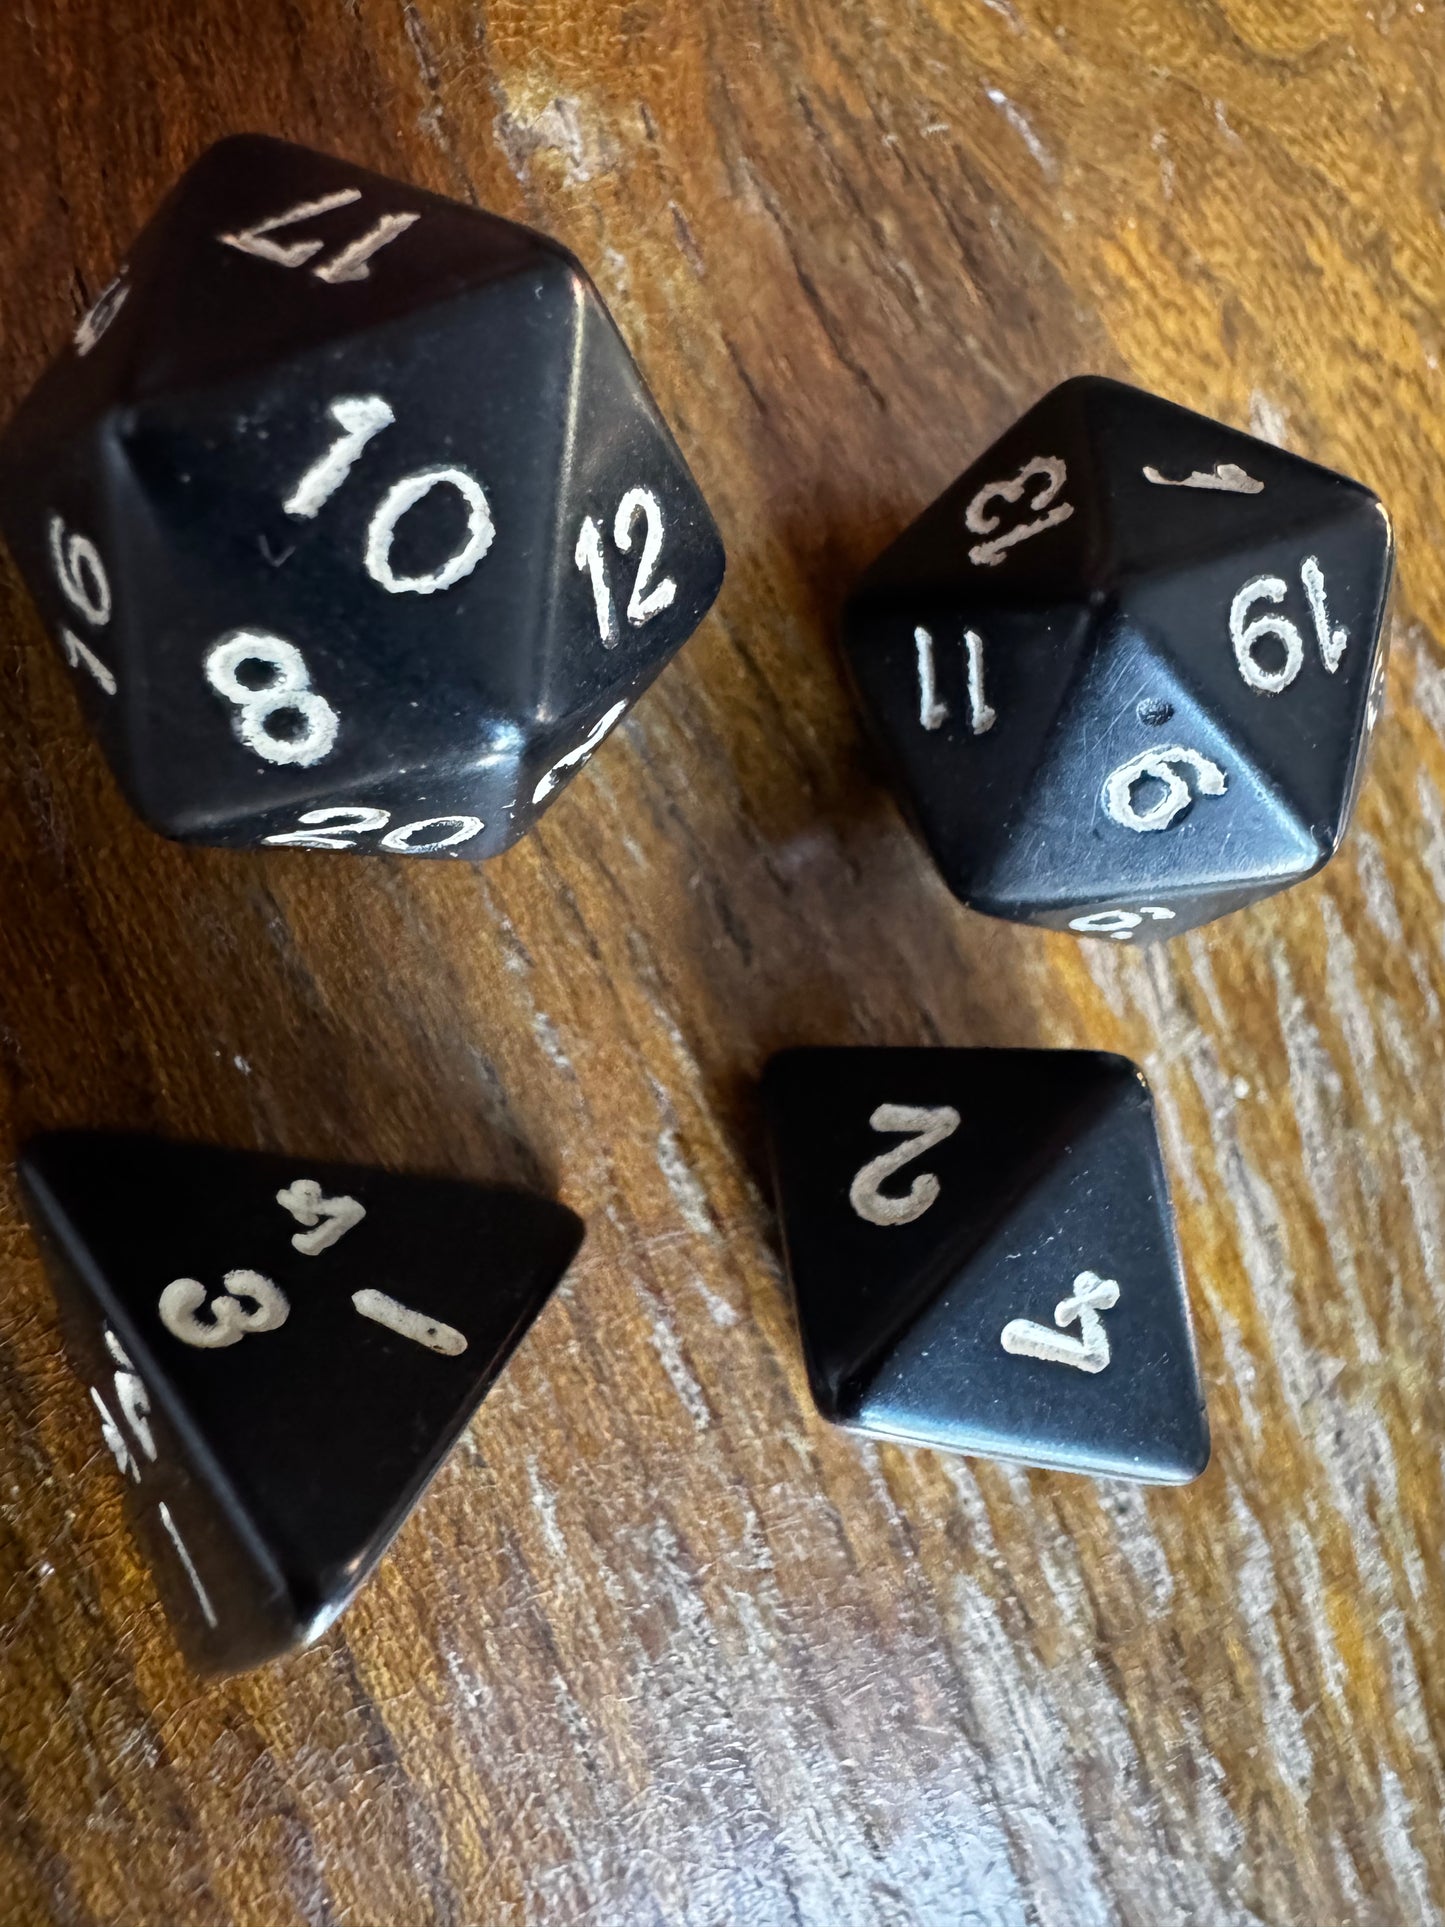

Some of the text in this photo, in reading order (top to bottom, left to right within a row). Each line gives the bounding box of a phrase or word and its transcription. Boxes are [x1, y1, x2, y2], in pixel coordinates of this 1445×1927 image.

[283, 395, 497, 595] 10
[574, 487, 678, 645] 12
[205, 631, 340, 767] 8
[913, 626, 995, 735] 11
[264, 806, 485, 854] 20
[275, 1179, 367, 1256] 4
[849, 1103, 961, 1227] 2
[158, 1269, 290, 1348] 3
[351, 1288, 469, 1356] 1
[1000, 1270, 1121, 1374] 4
